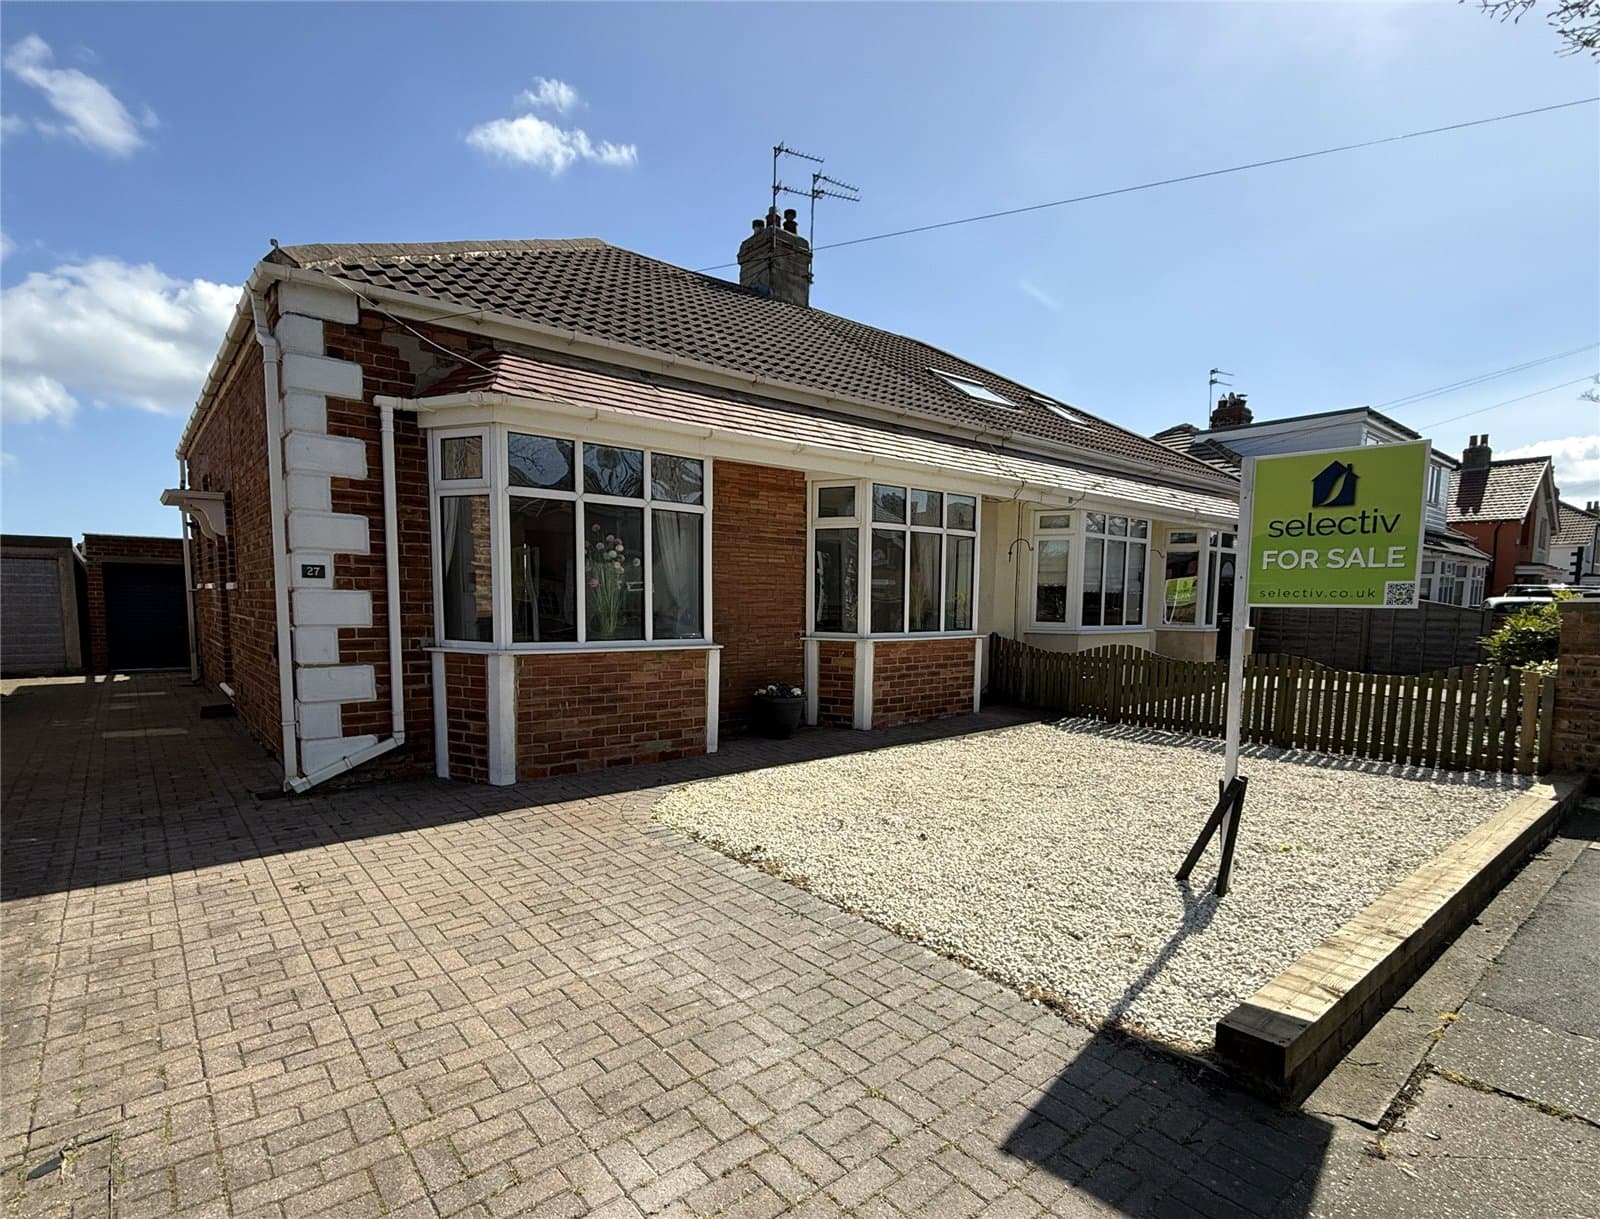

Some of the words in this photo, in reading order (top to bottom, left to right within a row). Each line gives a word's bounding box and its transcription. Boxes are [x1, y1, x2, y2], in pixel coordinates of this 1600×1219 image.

[1268, 508, 1400, 538] selectiv
[1262, 549, 1319, 570] FOR
[1326, 546, 1406, 569] SALE
[306, 566, 320, 576] 27
[1259, 586, 1376, 599] selectiv.co.uk
